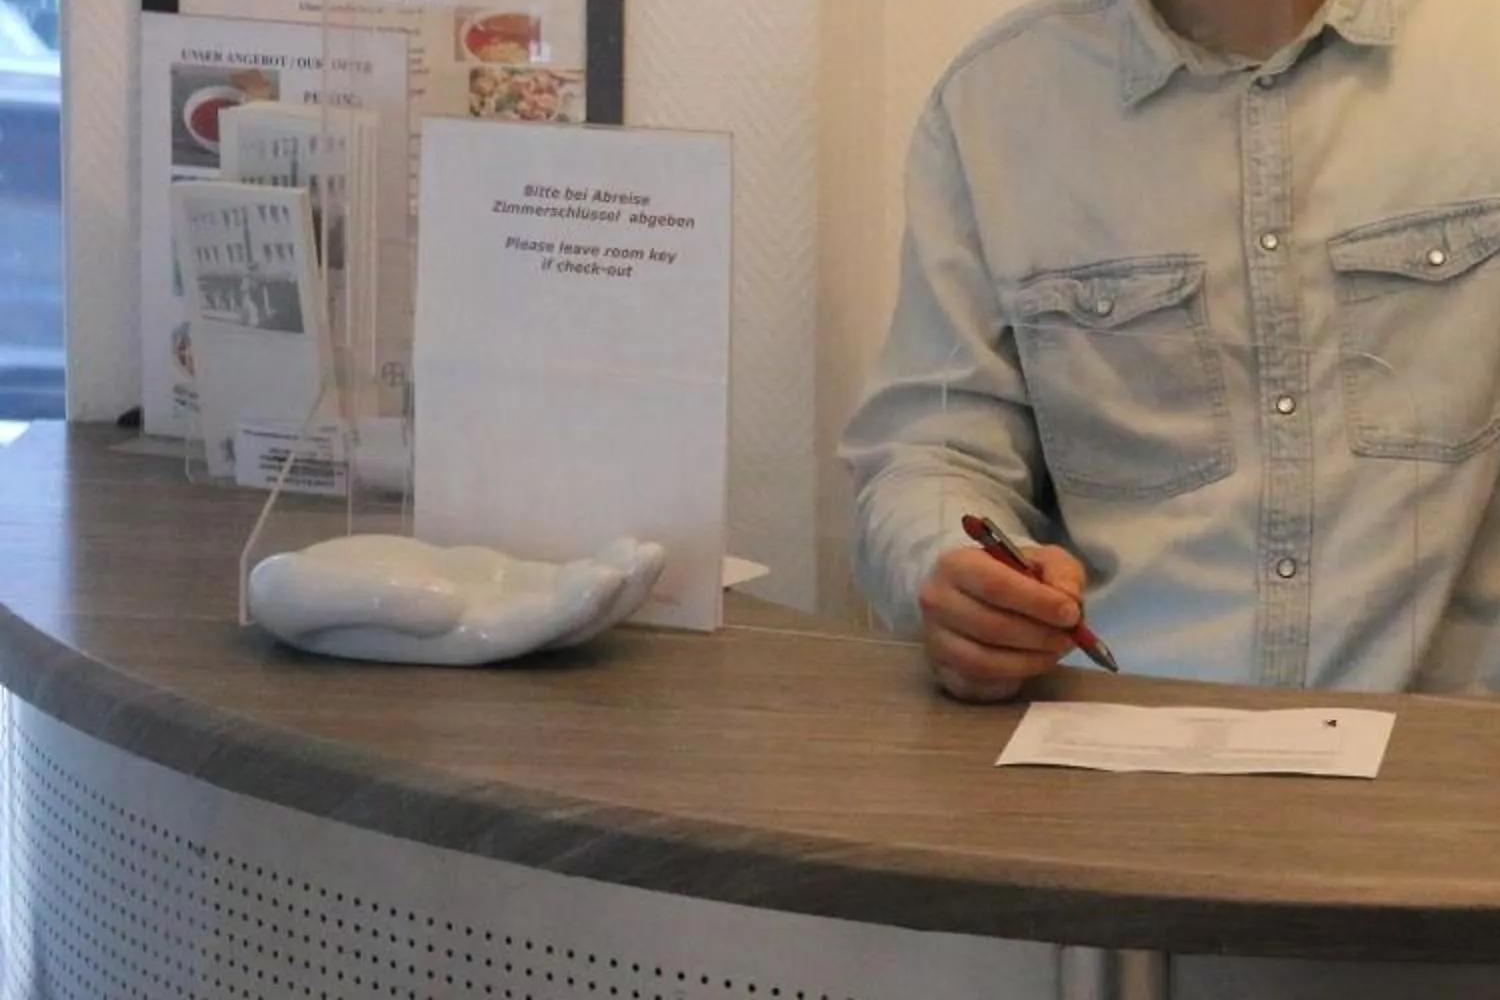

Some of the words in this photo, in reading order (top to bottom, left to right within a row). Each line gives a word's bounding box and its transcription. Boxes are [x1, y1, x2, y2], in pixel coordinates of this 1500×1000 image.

[181, 48, 223, 62] UNSER
[226, 51, 287, 68] ANGEBOT
[522, 183, 560, 199] Bitte
[564, 186, 589, 201] bei
[591, 188, 651, 206] Abreise
[492, 200, 620, 221] Zimmerschlüssel
[629, 212, 696, 229] abgeben
[505, 236, 555, 252] Please
[559, 241, 600, 256] leave
[604, 246, 645, 260] room
[648, 247, 679, 265] key
[540, 257, 553, 271] if
[556, 259, 634, 278] check-out
